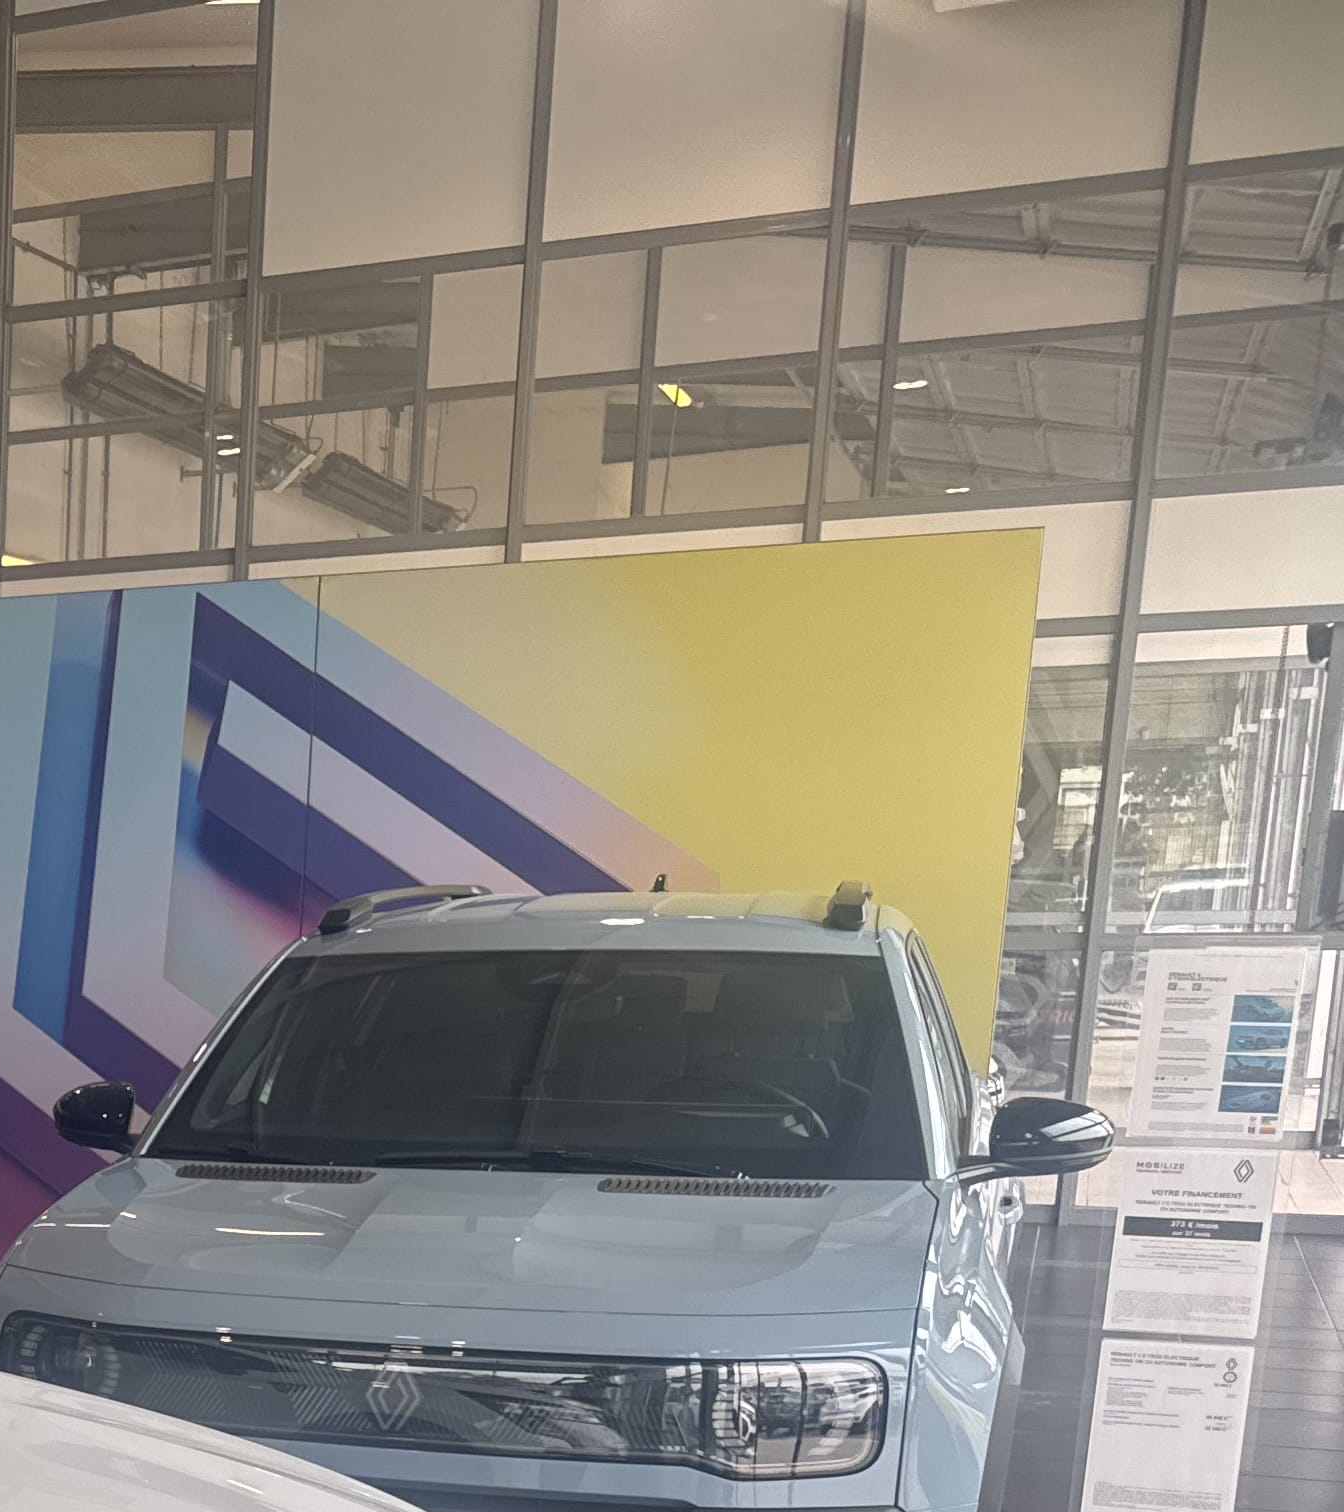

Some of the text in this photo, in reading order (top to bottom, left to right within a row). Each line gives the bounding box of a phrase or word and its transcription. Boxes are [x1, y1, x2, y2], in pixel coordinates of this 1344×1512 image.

[1136, 1161, 1184, 1170] MOBILIZE
[1152, 1189, 1243, 1199] VOTRE FINANCEMENT
